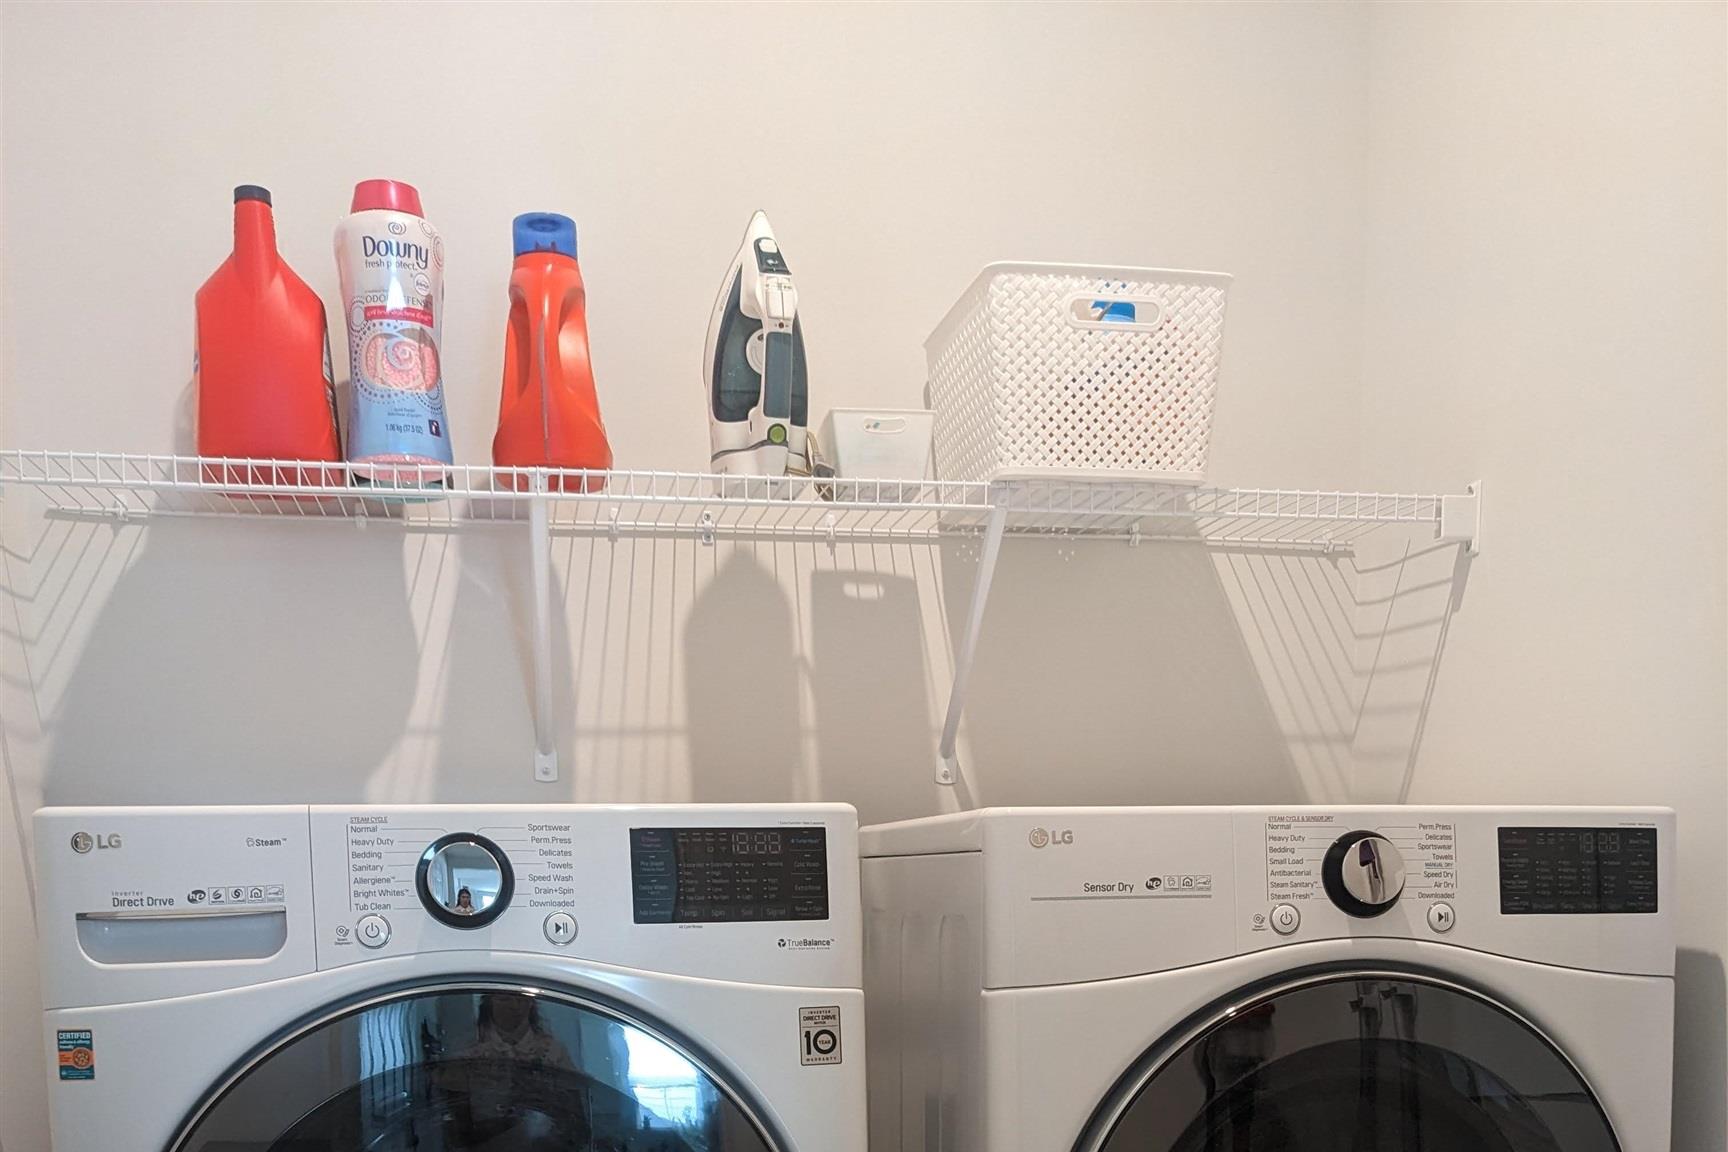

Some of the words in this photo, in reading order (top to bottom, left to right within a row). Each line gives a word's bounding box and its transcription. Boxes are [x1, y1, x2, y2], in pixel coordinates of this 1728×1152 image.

[362, 235, 429, 270] Downy
[365, 258, 386, 269] fresh
[350, 825, 378, 833] Normal
[527, 824, 571, 832] Sportswear
[97, 834, 122, 849] LG
[1051, 830, 1074, 845] LG
[1268, 835, 1289, 843] Heavy
[1290, 834, 1306, 842] Duty
[351, 838, 375, 847] Heavy
[376, 838, 394, 846] Duty
[1417, 843, 1452, 851] Sportswear
[539, 849, 573, 857] Delicates
[1269, 846, 1295, 854] Bedding
[352, 851, 382, 860] Bedding
[352, 864, 384, 873] Sanitary
[547, 861, 573, 869] Towels
[528, 874, 551, 883] Speed
[552, 874, 573, 882] Wash
[1423, 871, 1443, 879] Speed
[1083, 883, 1116, 893] Sensor
[1118, 882, 1134, 893] Dry
[1270, 881, 1289, 889] Steam
[353, 890, 377, 899] Bright
[1270, 893, 1291, 901] Steam
[1418, 891, 1455, 899] Downloaded
[112, 897, 144, 907] Direct
[147, 896, 175, 906] Drive
[529, 899, 575, 908] Downloaded
[355, 903, 369, 911] Tub
[370, 902, 391, 910] Clean
[804, 1029, 837, 1055] 10
